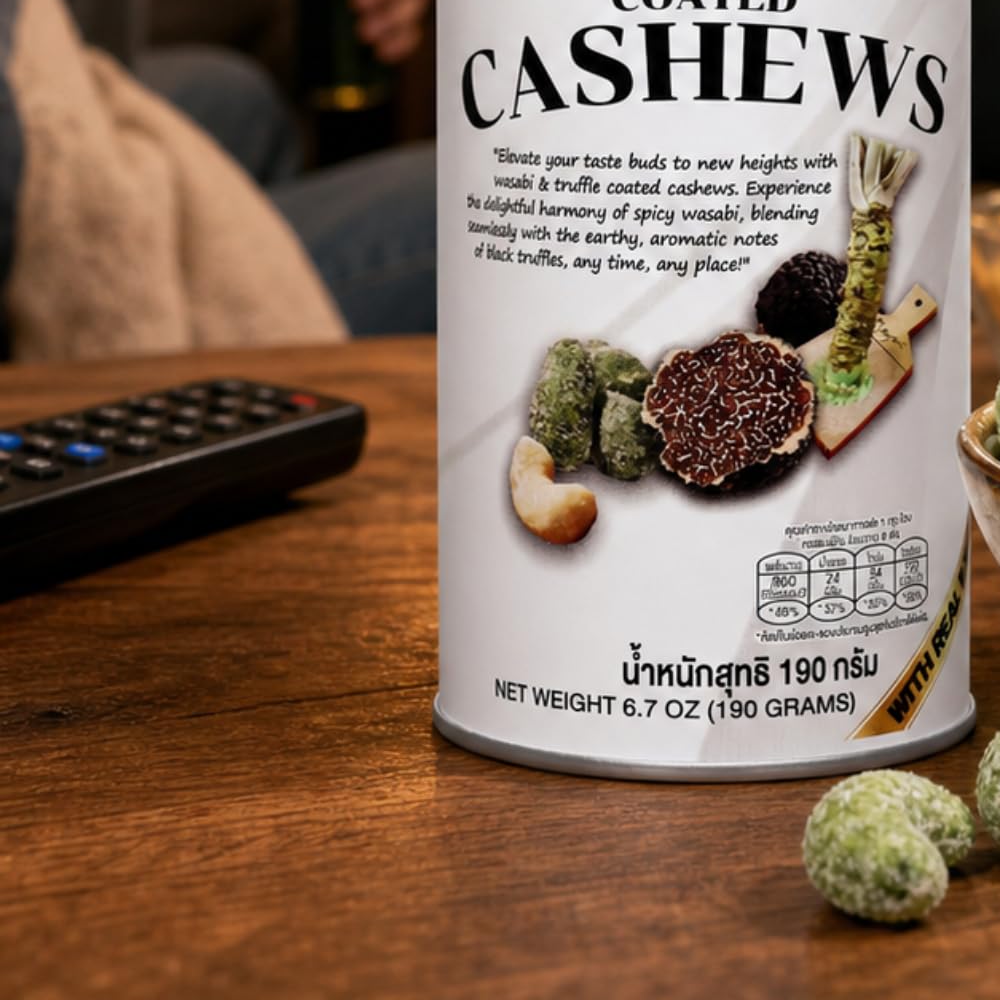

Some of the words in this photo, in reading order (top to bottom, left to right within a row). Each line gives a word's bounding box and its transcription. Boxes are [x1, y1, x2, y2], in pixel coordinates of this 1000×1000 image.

[461, 22, 949, 135] CASHEWS
[545, 154, 580, 171] your
[583, 153, 622, 170] taste
[628, 152, 667, 170] buds
[673, 155, 691, 170] to
[698, 157, 734, 171] new
[740, 154, 798, 175] heights
[803, 152, 838, 169] with
[493, 173, 535, 191] wasabi
[538, 176, 550, 192] &
[554, 175, 600, 194] truffle
[606, 178, 661, 195] coated
[667, 179, 739, 196] cashews.
[745, 179, 832, 200] Experience
[539, 200, 606, 225] harmony
[612, 202, 630, 221] of
[633, 204, 675, 227] spicy
[681, 204, 745, 224] wasabi,
[751, 203, 819, 225] blending
[521, 225, 551, 241] with
[556, 227, 580, 244] the
[585, 229, 644, 250] earthy,
[650, 230, 727, 246] aromatic
[733, 231, 779, 246] notes
[517, 249, 568, 270] truffles,
[573, 256, 602, 275] any
[607, 254, 650, 273] time,
[656, 258, 688, 277] any
[779, 656, 826, 686] 190
[833, 647, 878, 682] กรัม
[495, 678, 527, 701] NET
[532, 686, 616, 715] WEIGHT
[622, 698, 657, 718] 6.7
[664, 699, 701, 720] OZ
[707, 698, 758, 725] (190
[764, 691, 855, 718] GRAMS)
